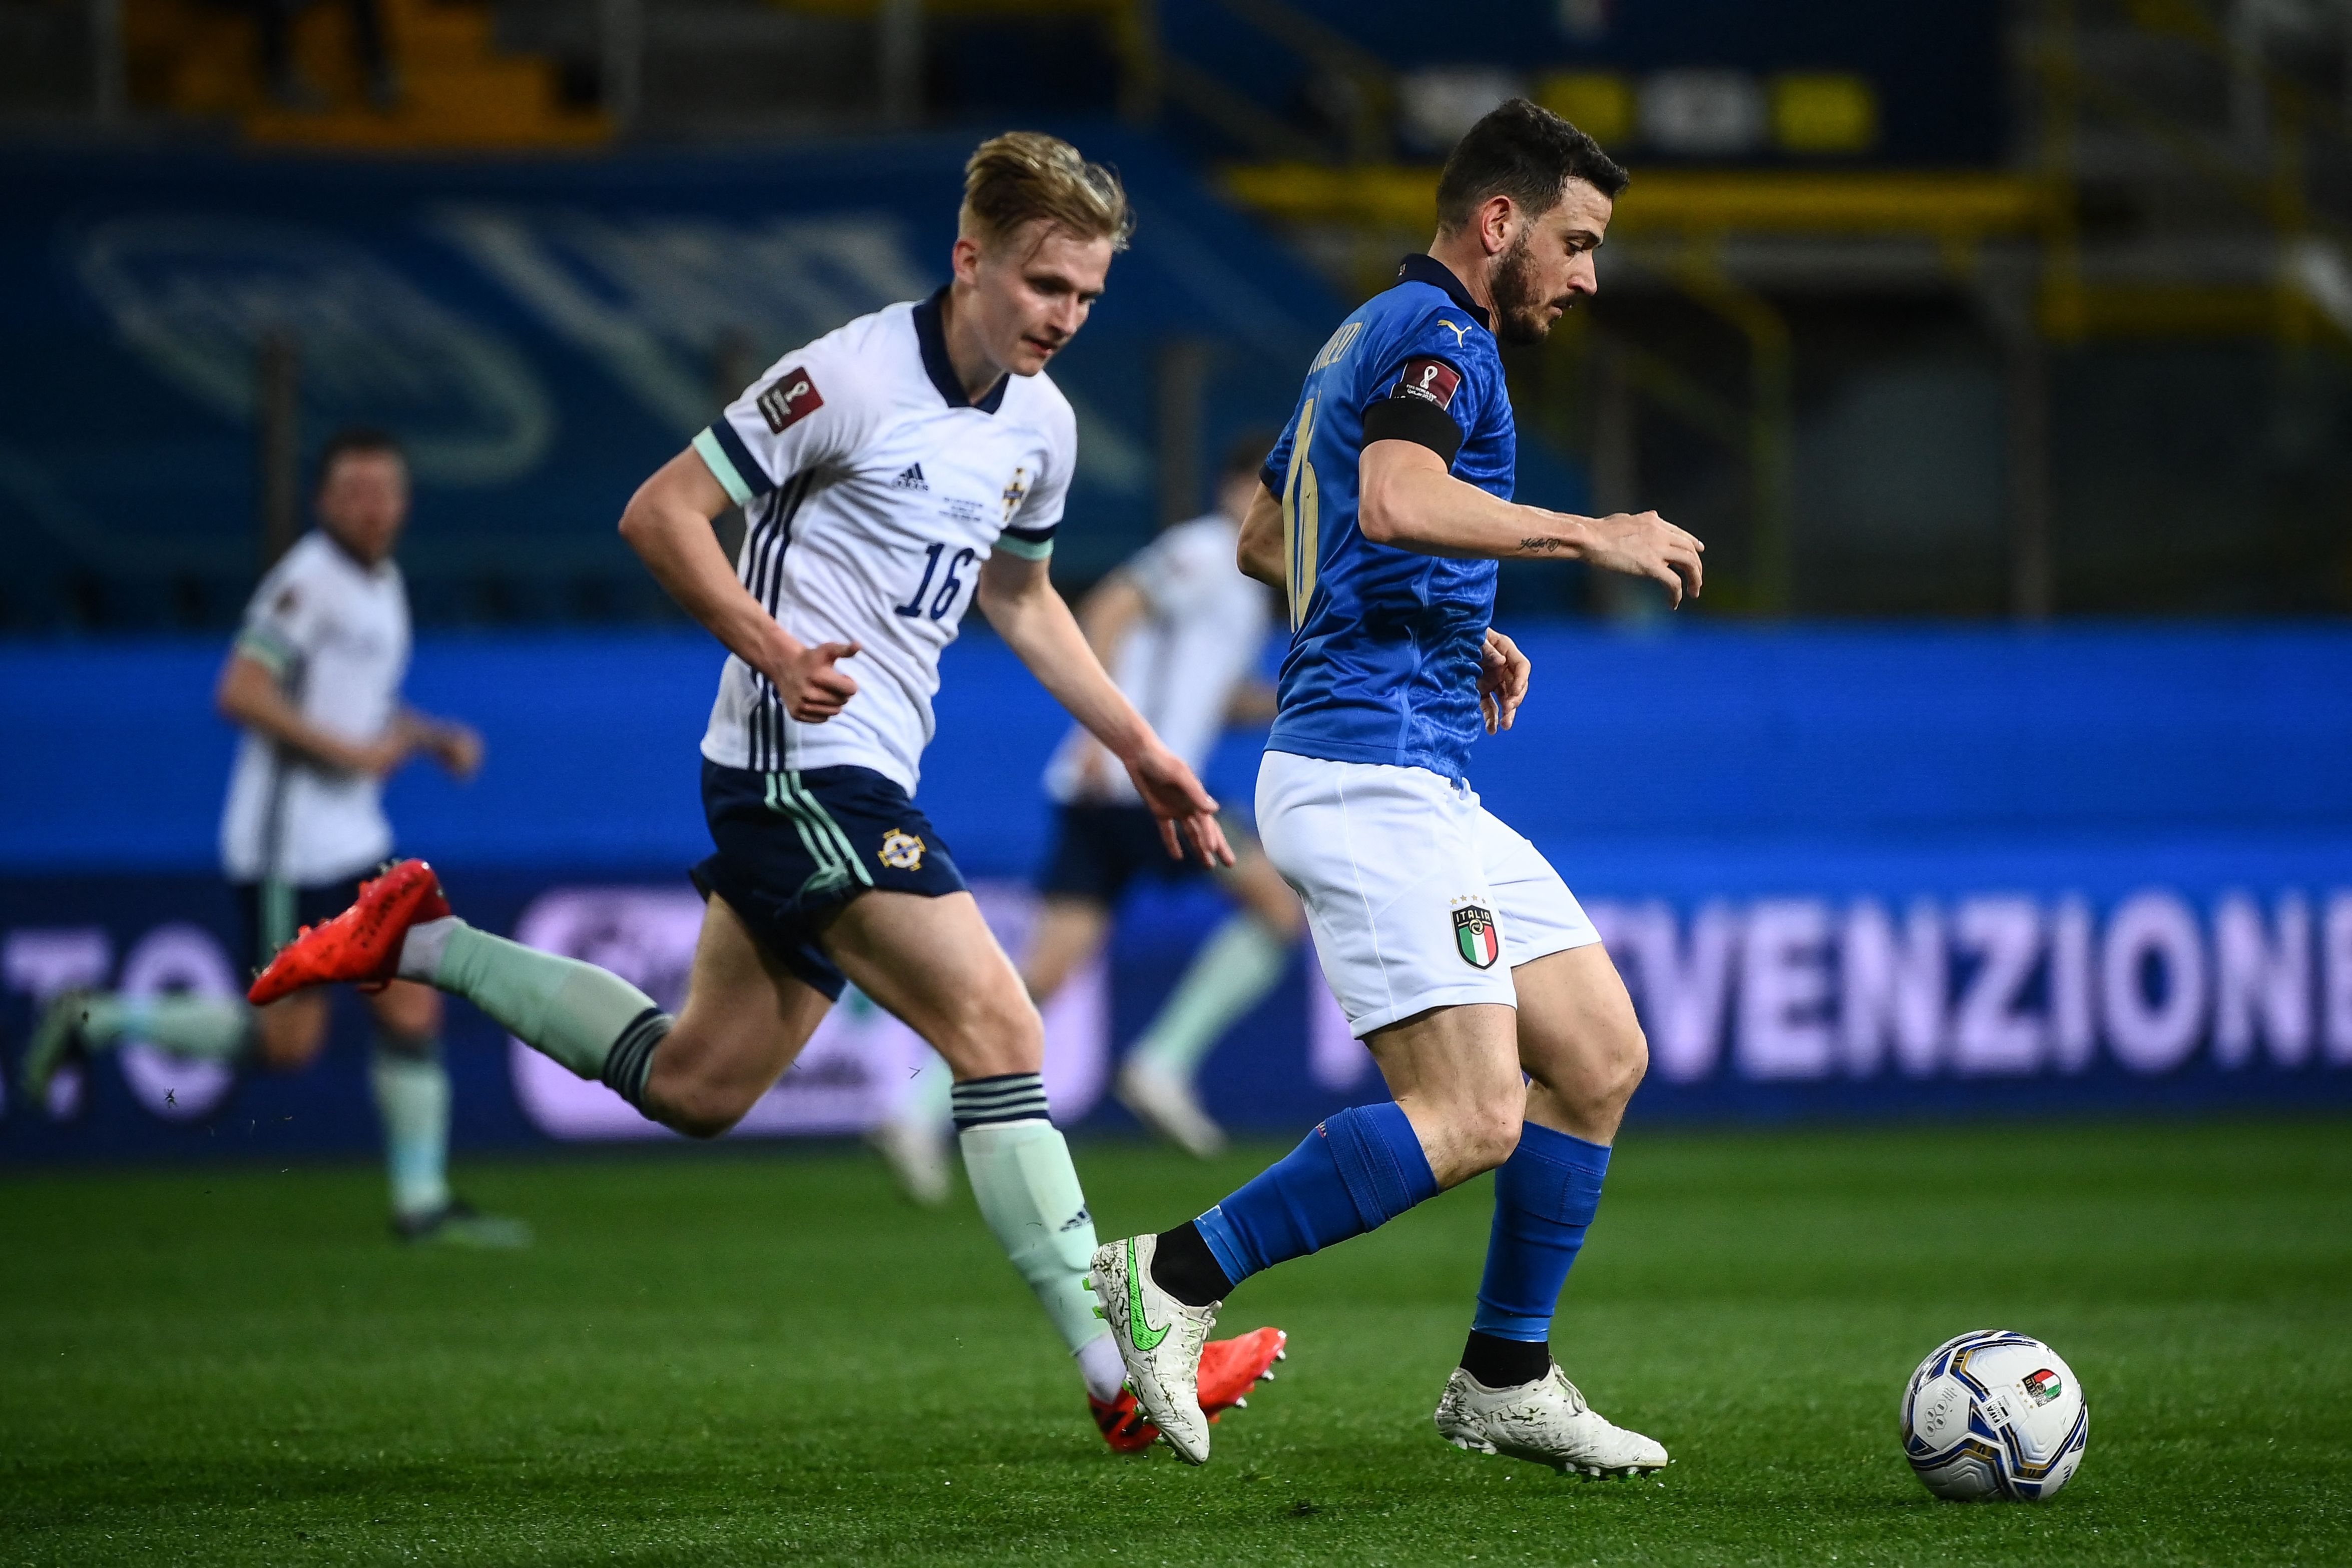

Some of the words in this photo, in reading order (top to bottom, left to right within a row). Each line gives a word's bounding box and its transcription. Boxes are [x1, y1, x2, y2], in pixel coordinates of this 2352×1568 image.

[1282, 389, 1321, 634] 16
[894, 543, 975, 620] 16
[1456, 909, 1491, 923] ITALIA
[0, 923, 244, 1120] TO
[1987, 1405, 2001, 1424] FIFA
